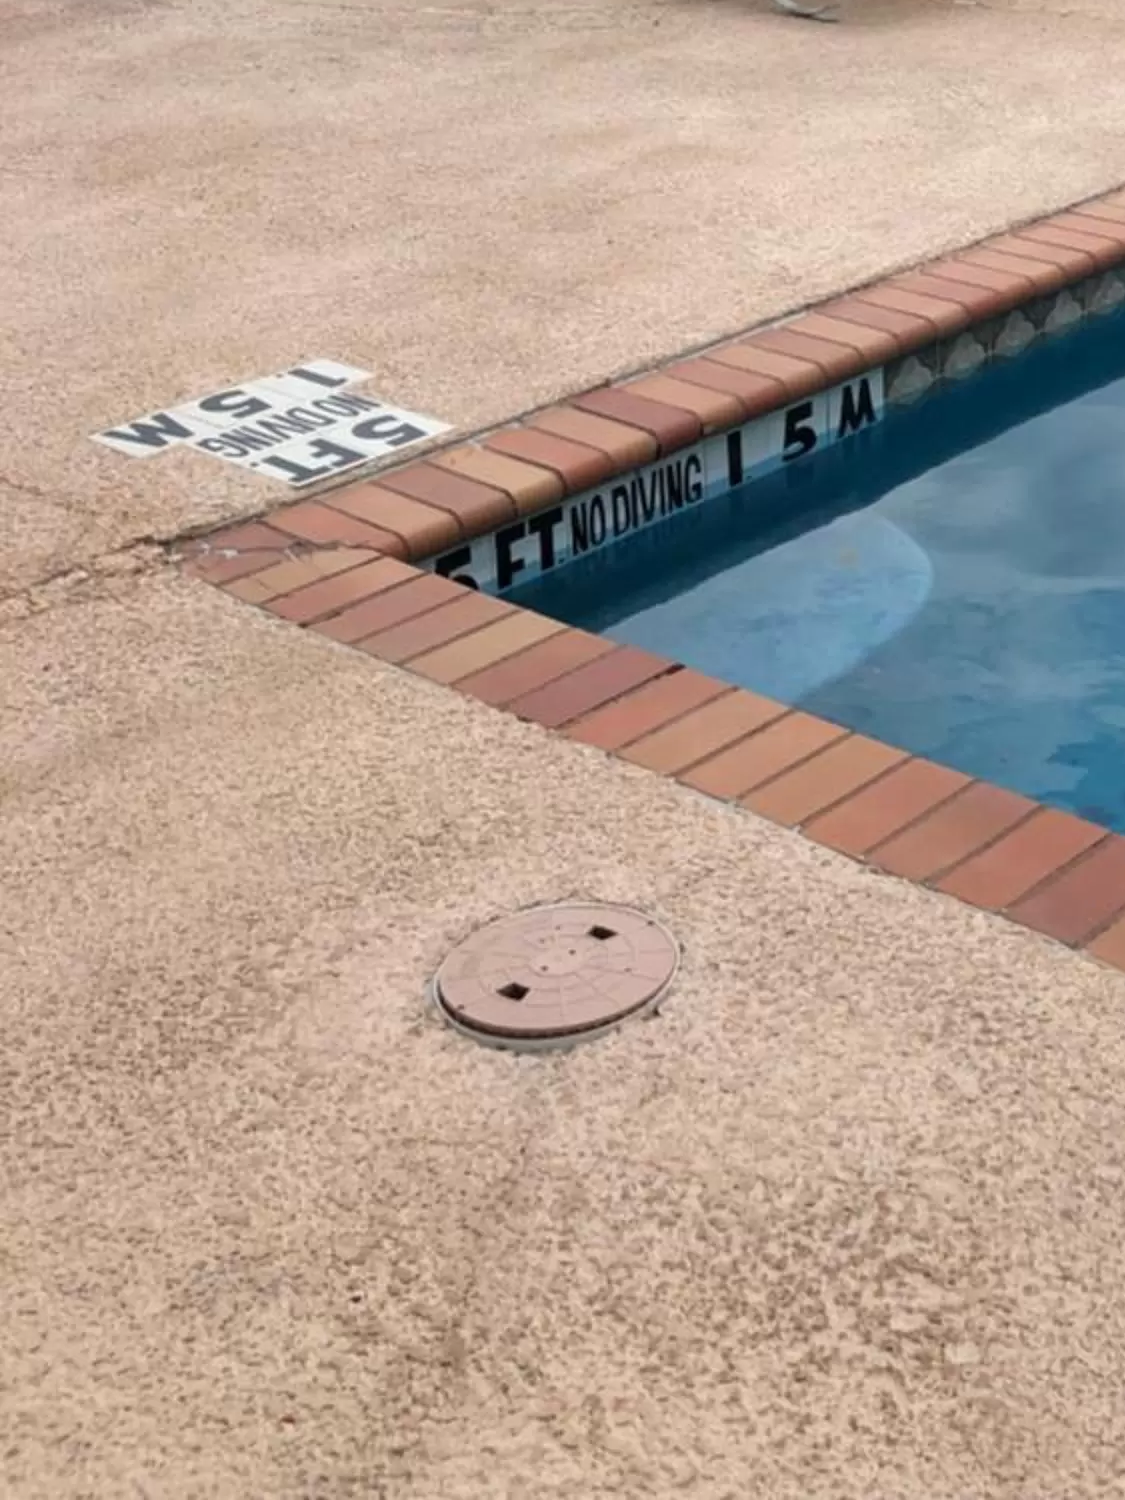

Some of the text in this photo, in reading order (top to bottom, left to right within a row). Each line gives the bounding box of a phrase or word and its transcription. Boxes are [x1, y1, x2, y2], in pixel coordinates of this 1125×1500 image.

[103, 413, 195, 449] M
[196, 392, 382, 458] NO DIVING
[352, 415, 427, 447] 5
[571, 494, 606, 557] NO
[612, 453, 703, 538] DIVING
[837, 377, 877, 439] M
